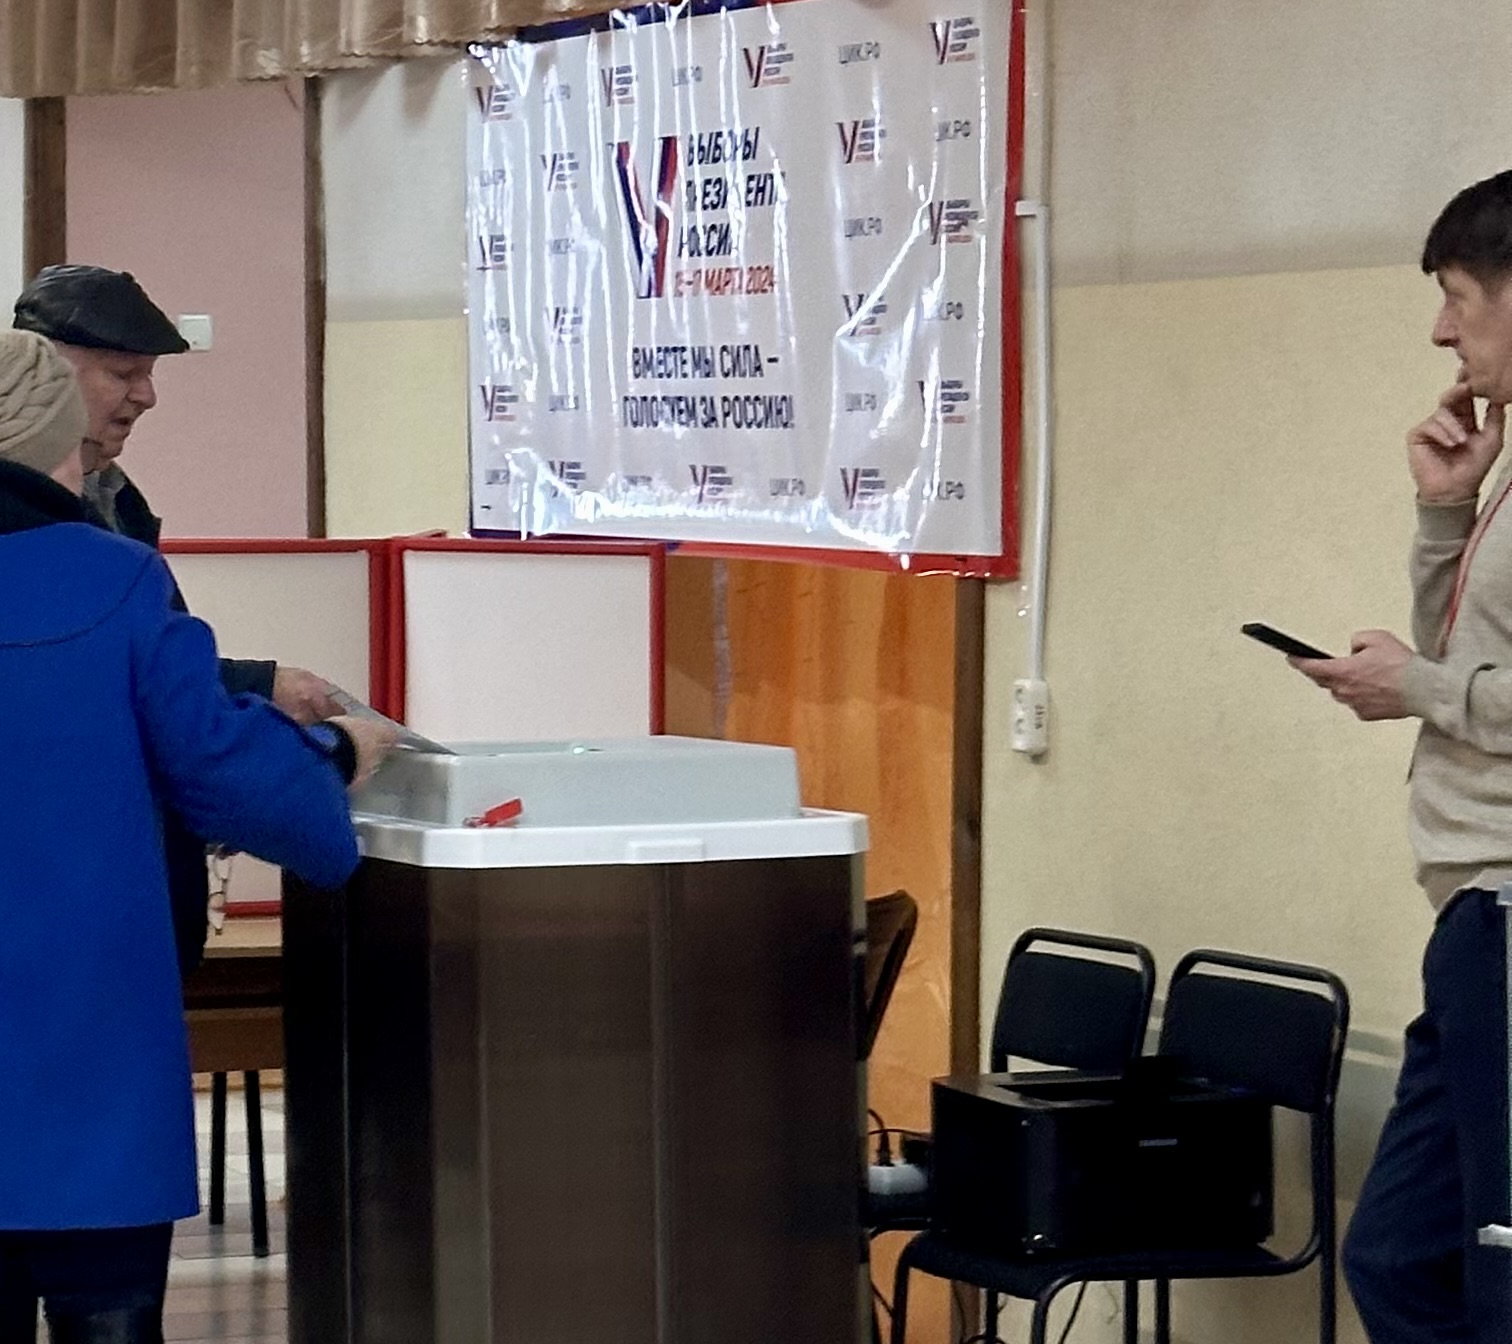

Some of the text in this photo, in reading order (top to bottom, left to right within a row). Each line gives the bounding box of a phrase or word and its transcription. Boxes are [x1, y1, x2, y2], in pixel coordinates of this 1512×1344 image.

[632, 346, 688, 378] ВМЕСТЕ
[691, 345, 716, 378] МЫ
[720, 344, 764, 378] СИЛА
[623, 395, 795, 428] ГОЛОСУЕМ ЗА РОССИЮ!
